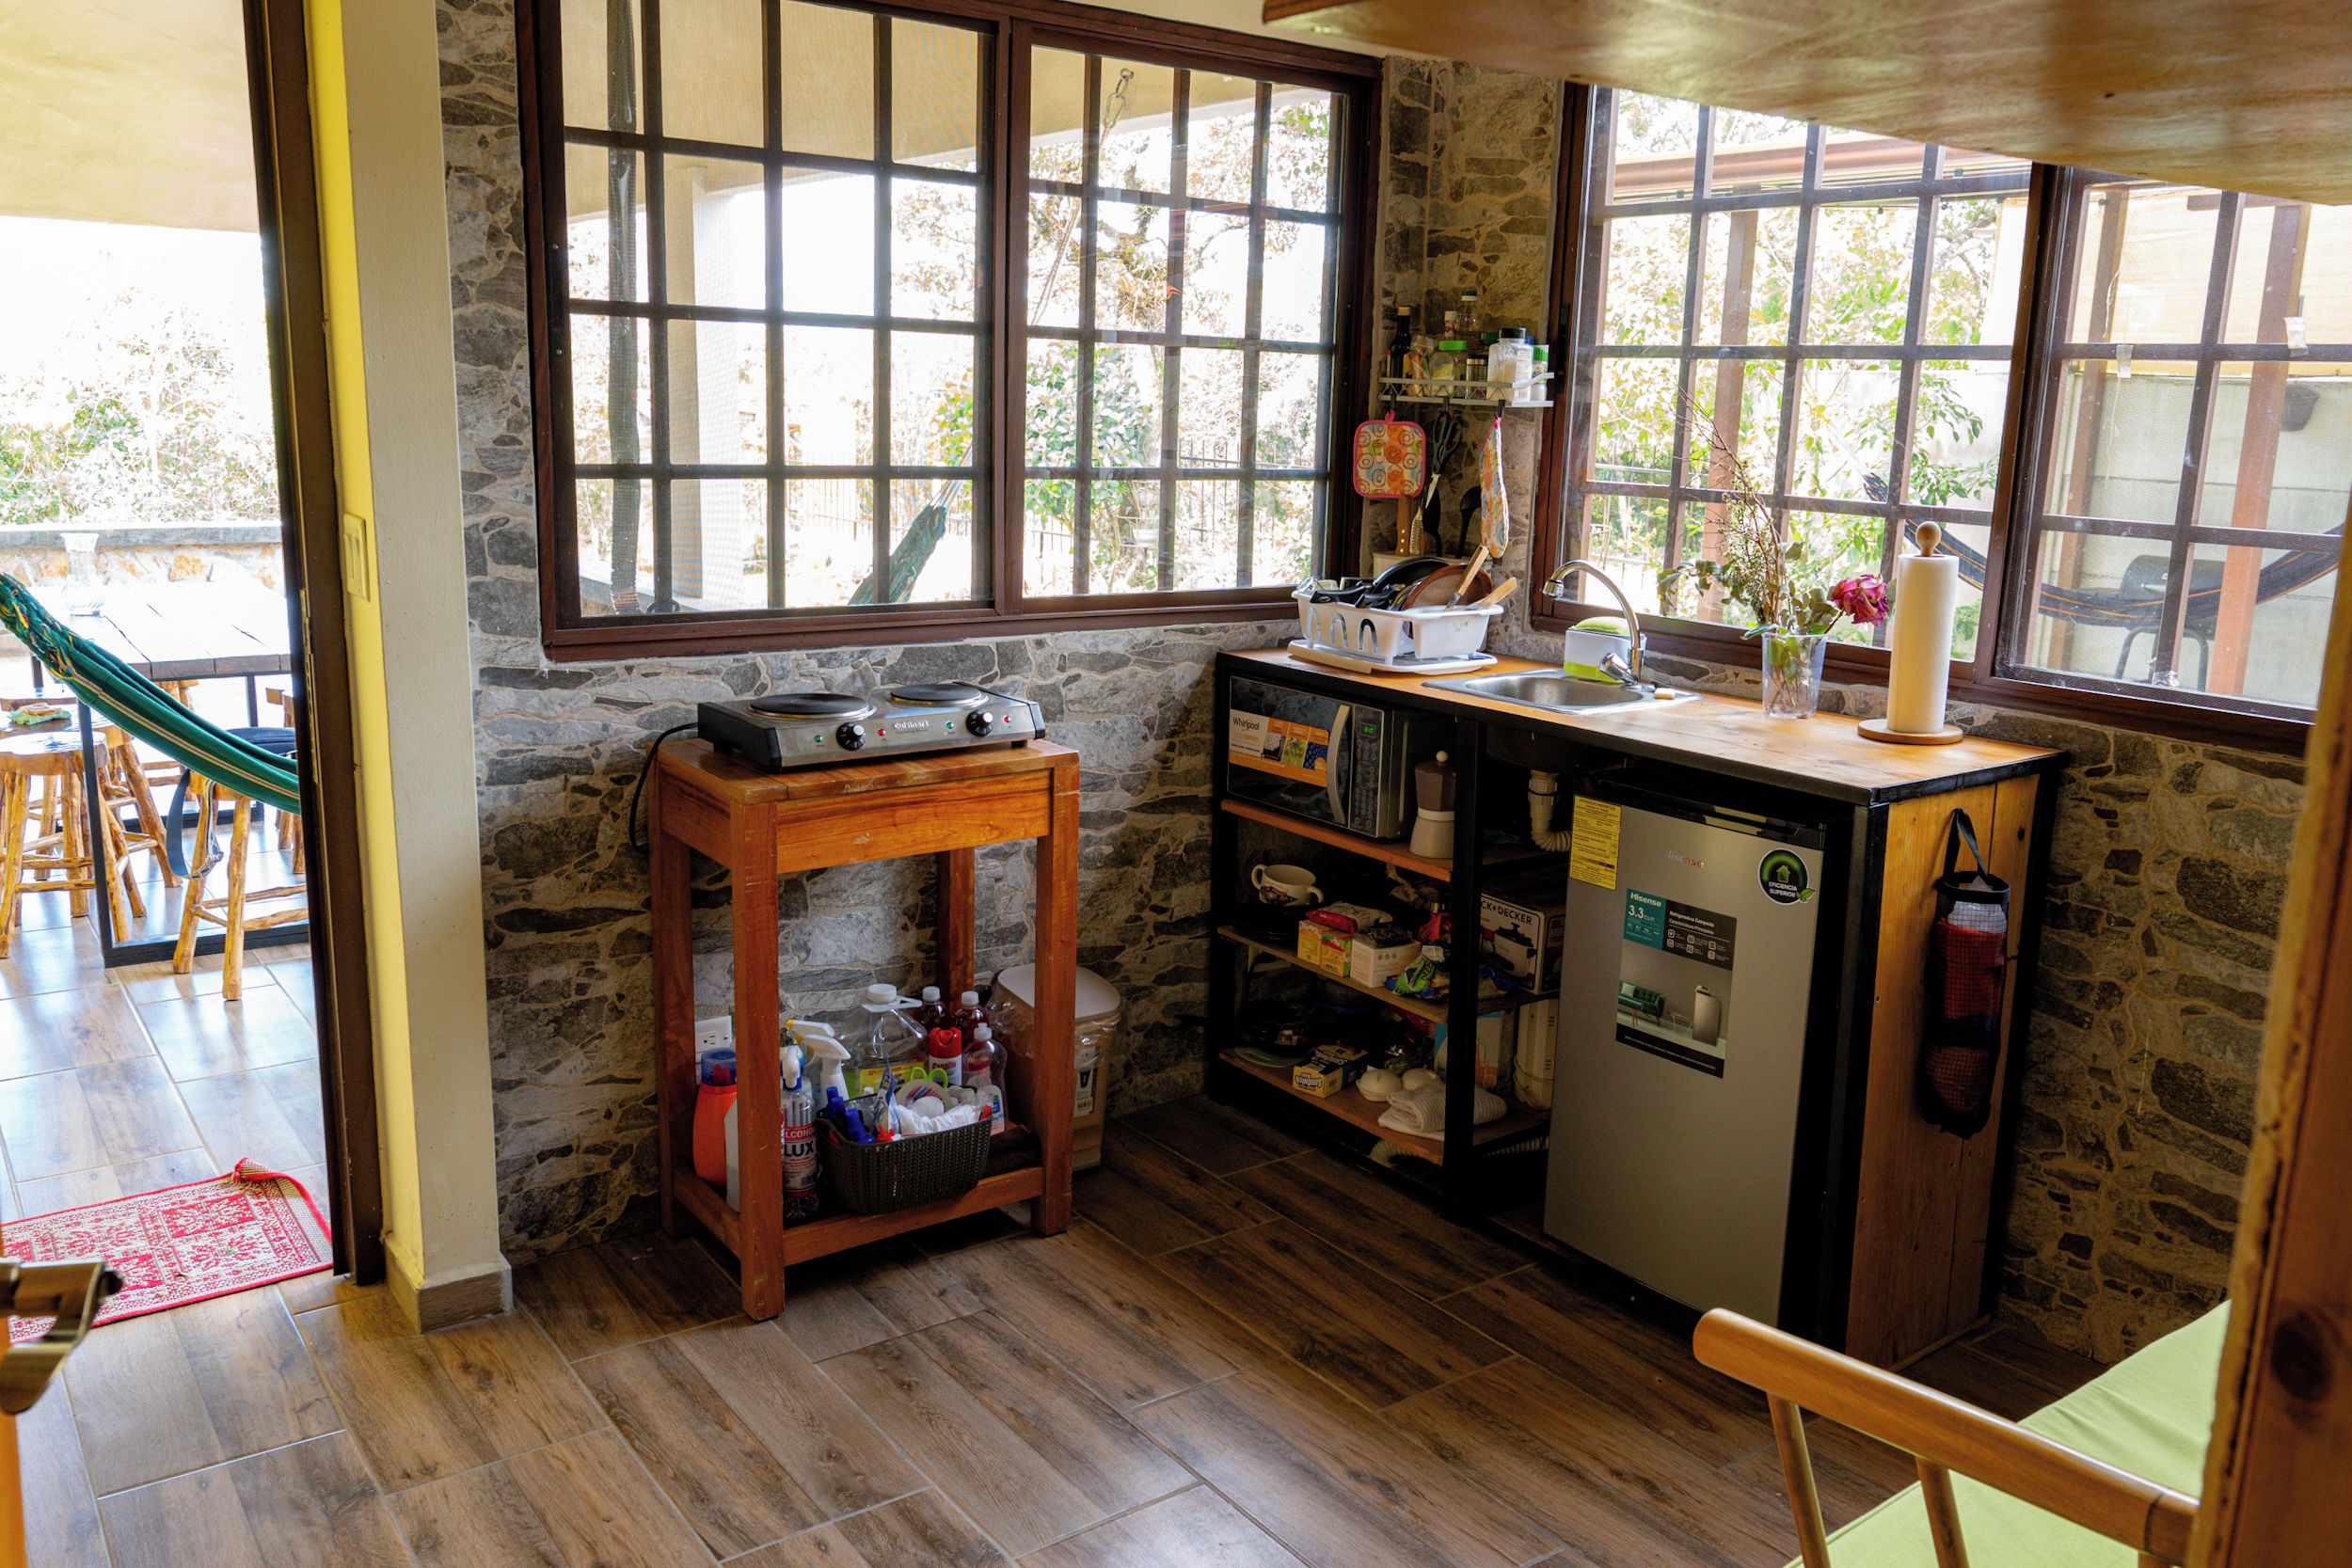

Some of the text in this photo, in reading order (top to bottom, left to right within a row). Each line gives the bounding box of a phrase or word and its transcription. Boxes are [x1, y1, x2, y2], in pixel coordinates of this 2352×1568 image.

[1232, 717, 1261, 730] Whirlpool
[1664, 849, 1705, 868] Hisense
[1769, 881, 1798, 892] EFICIENCIA
[1769, 888, 1796, 897] SUPERIOR
[1630, 892, 1662, 907] Hisense
[1629, 904, 1645, 919] 3.3
